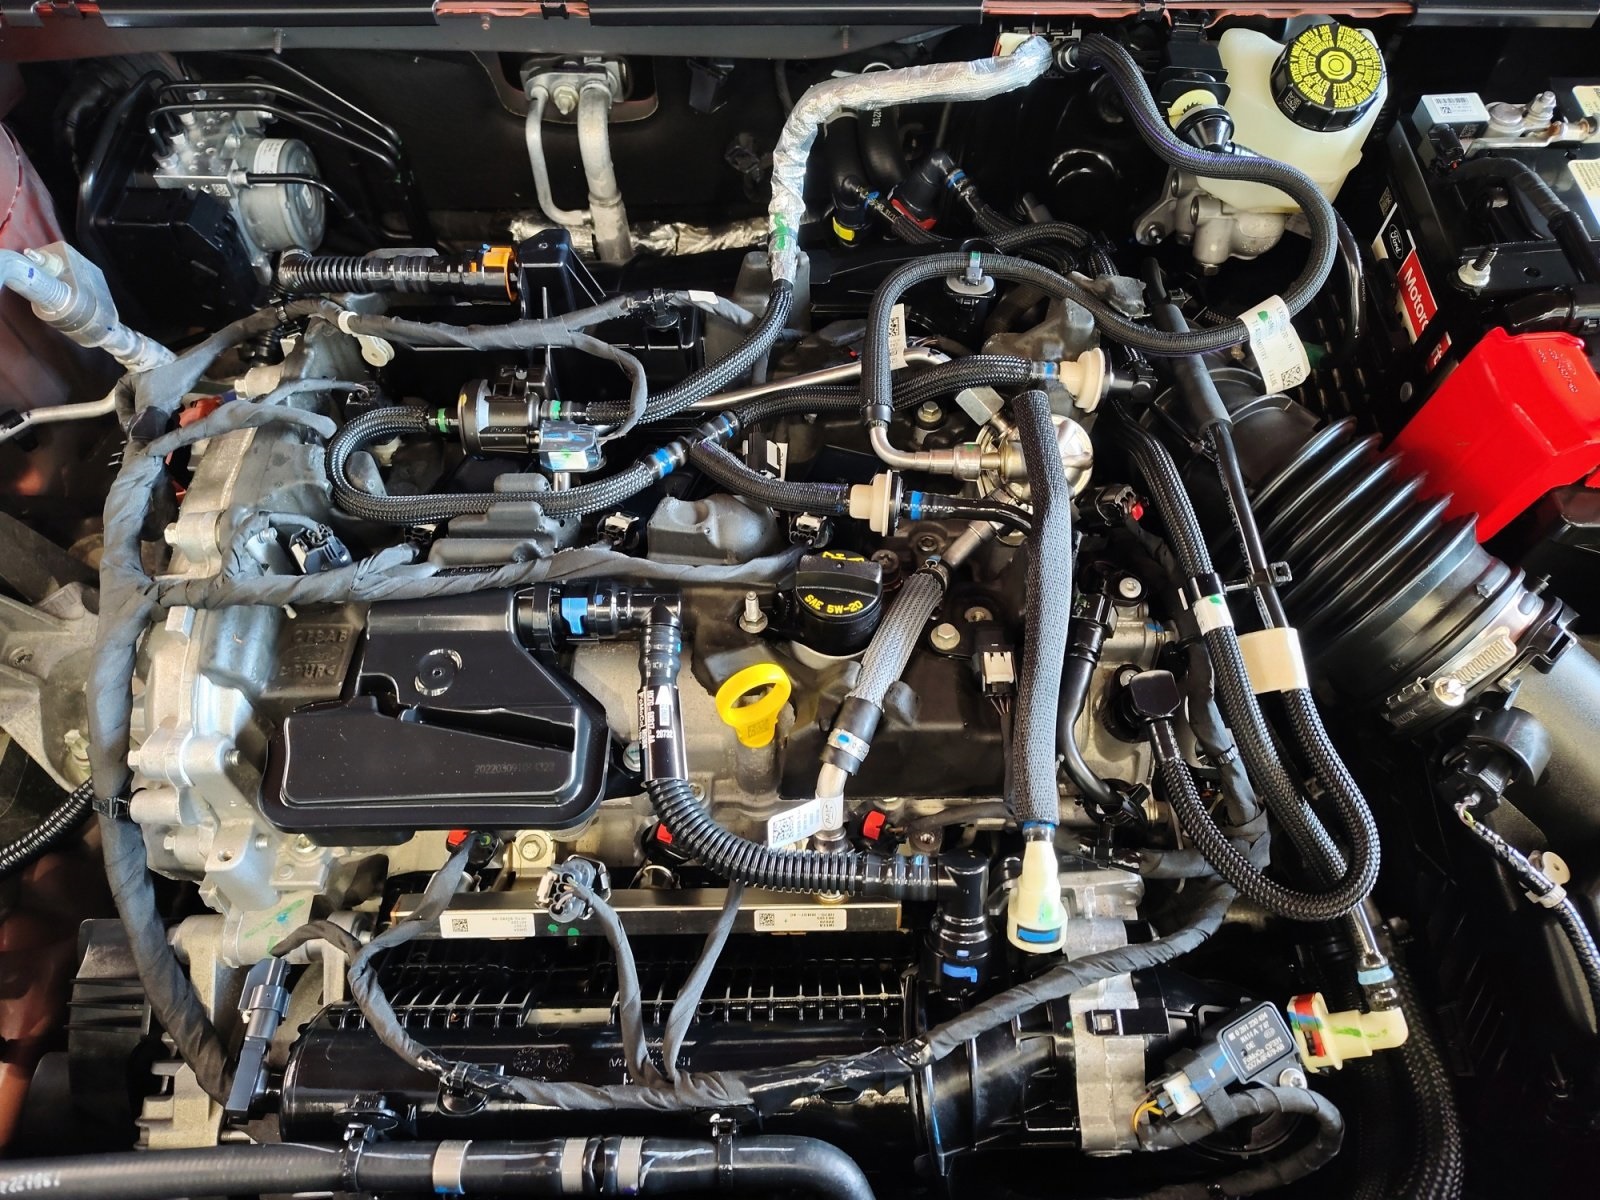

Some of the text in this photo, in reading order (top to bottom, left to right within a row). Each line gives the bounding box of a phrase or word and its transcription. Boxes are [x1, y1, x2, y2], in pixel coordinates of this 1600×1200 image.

[1389, 227, 1403, 255] Ford
[804, 594, 864, 614] SAE 5W-20
